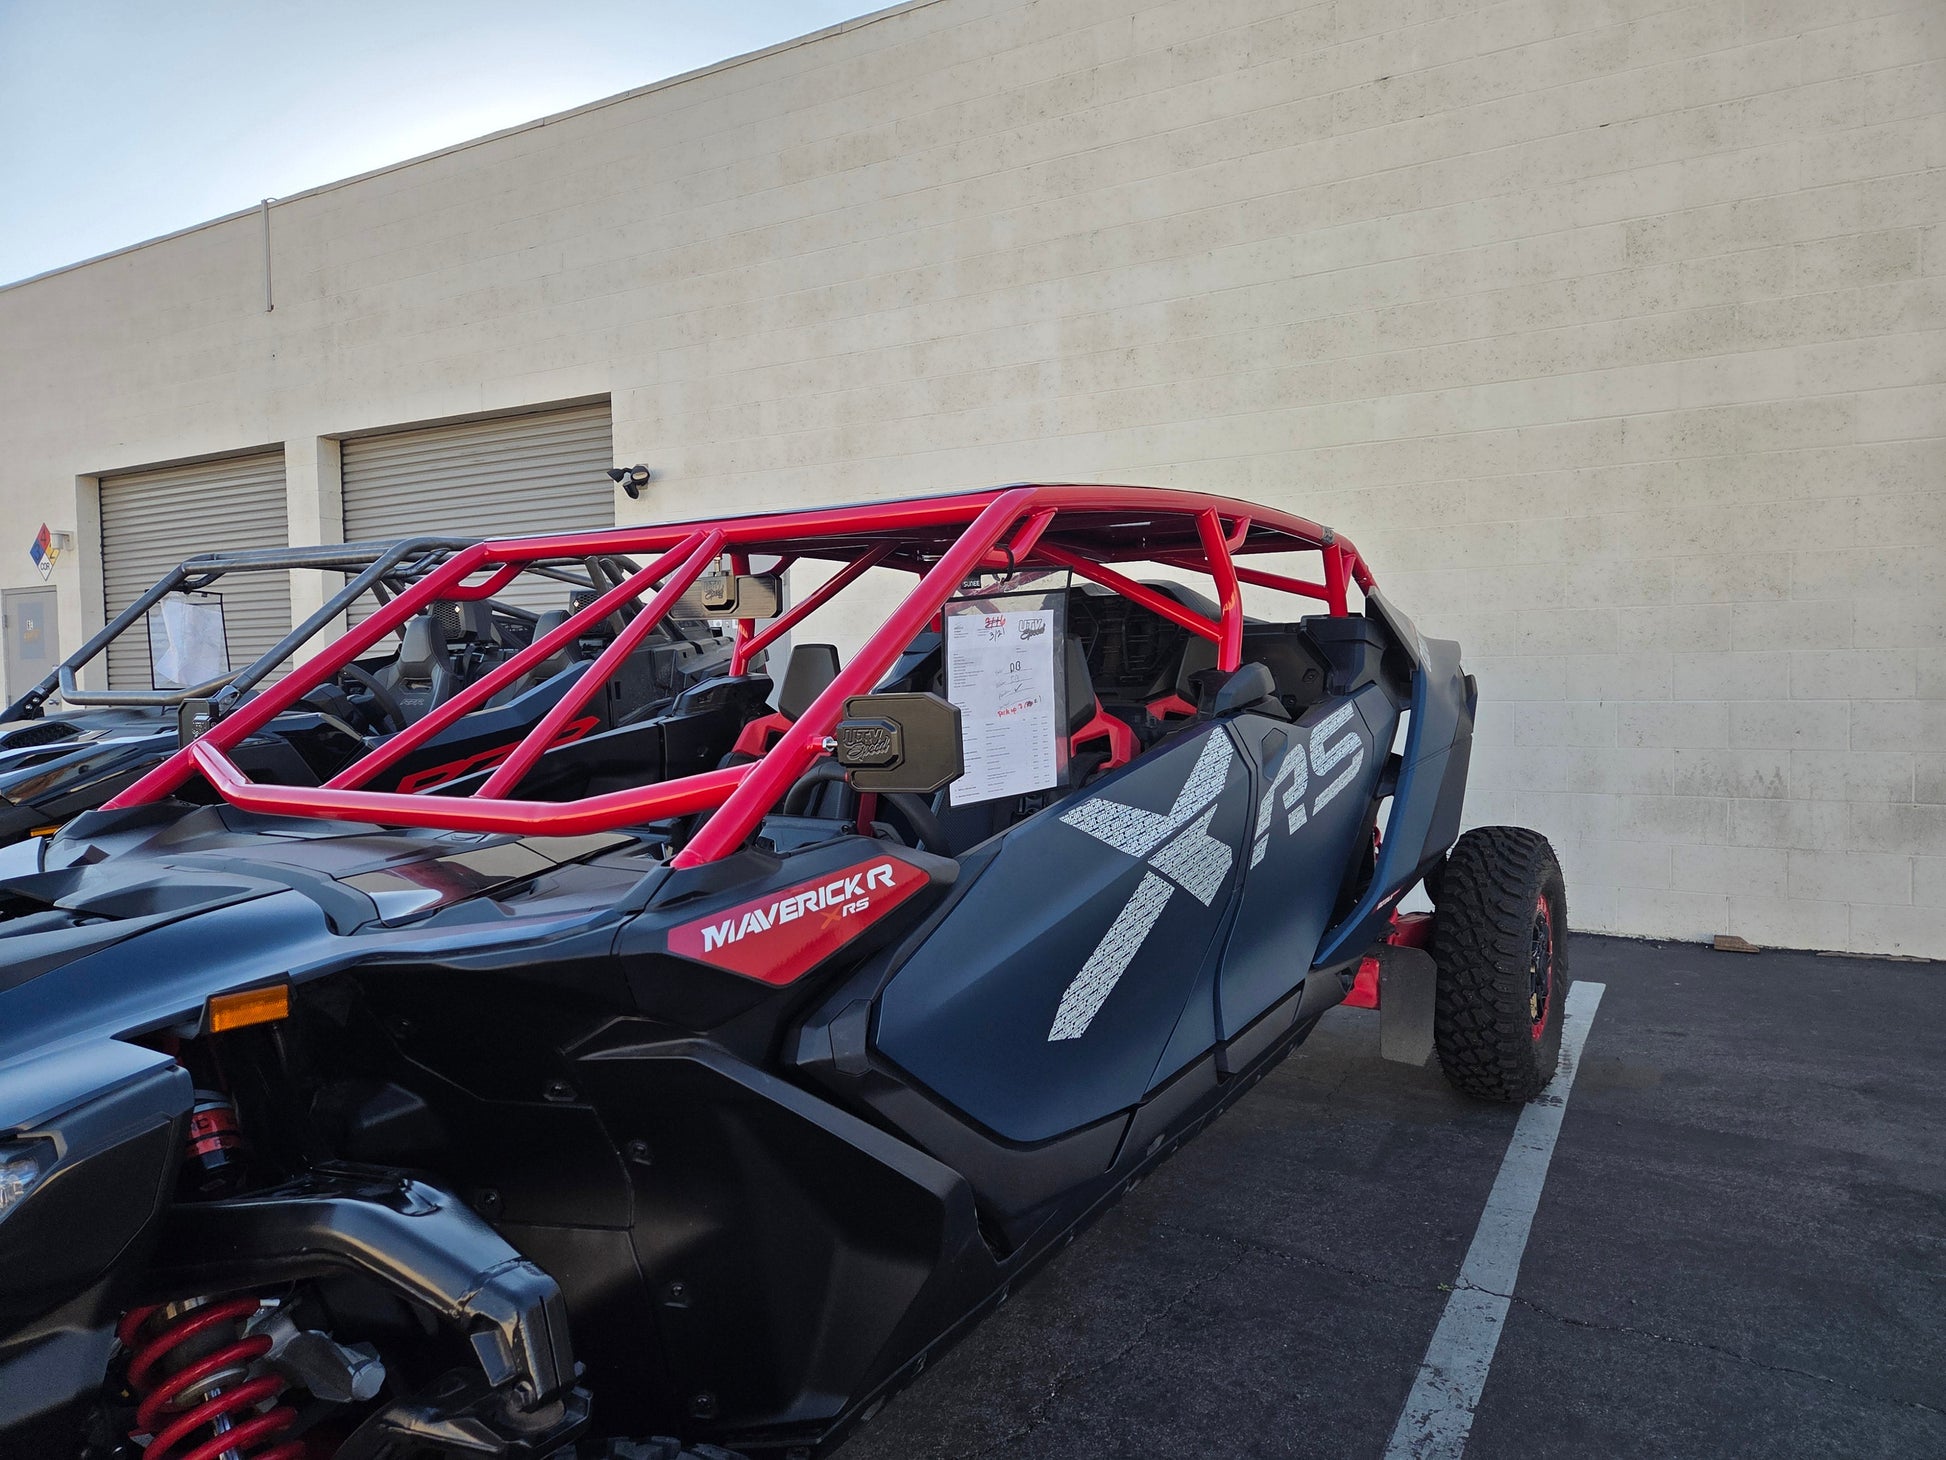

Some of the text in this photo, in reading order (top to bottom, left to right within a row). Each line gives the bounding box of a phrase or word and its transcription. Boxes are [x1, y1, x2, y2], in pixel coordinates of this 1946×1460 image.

[1019, 618, 1043, 632] UTV
[843, 728, 883, 746] UTV
[846, 735, 890, 762] Speed
[701, 863, 897, 953] MAVERICK R
[841, 896, 870, 918] RS
